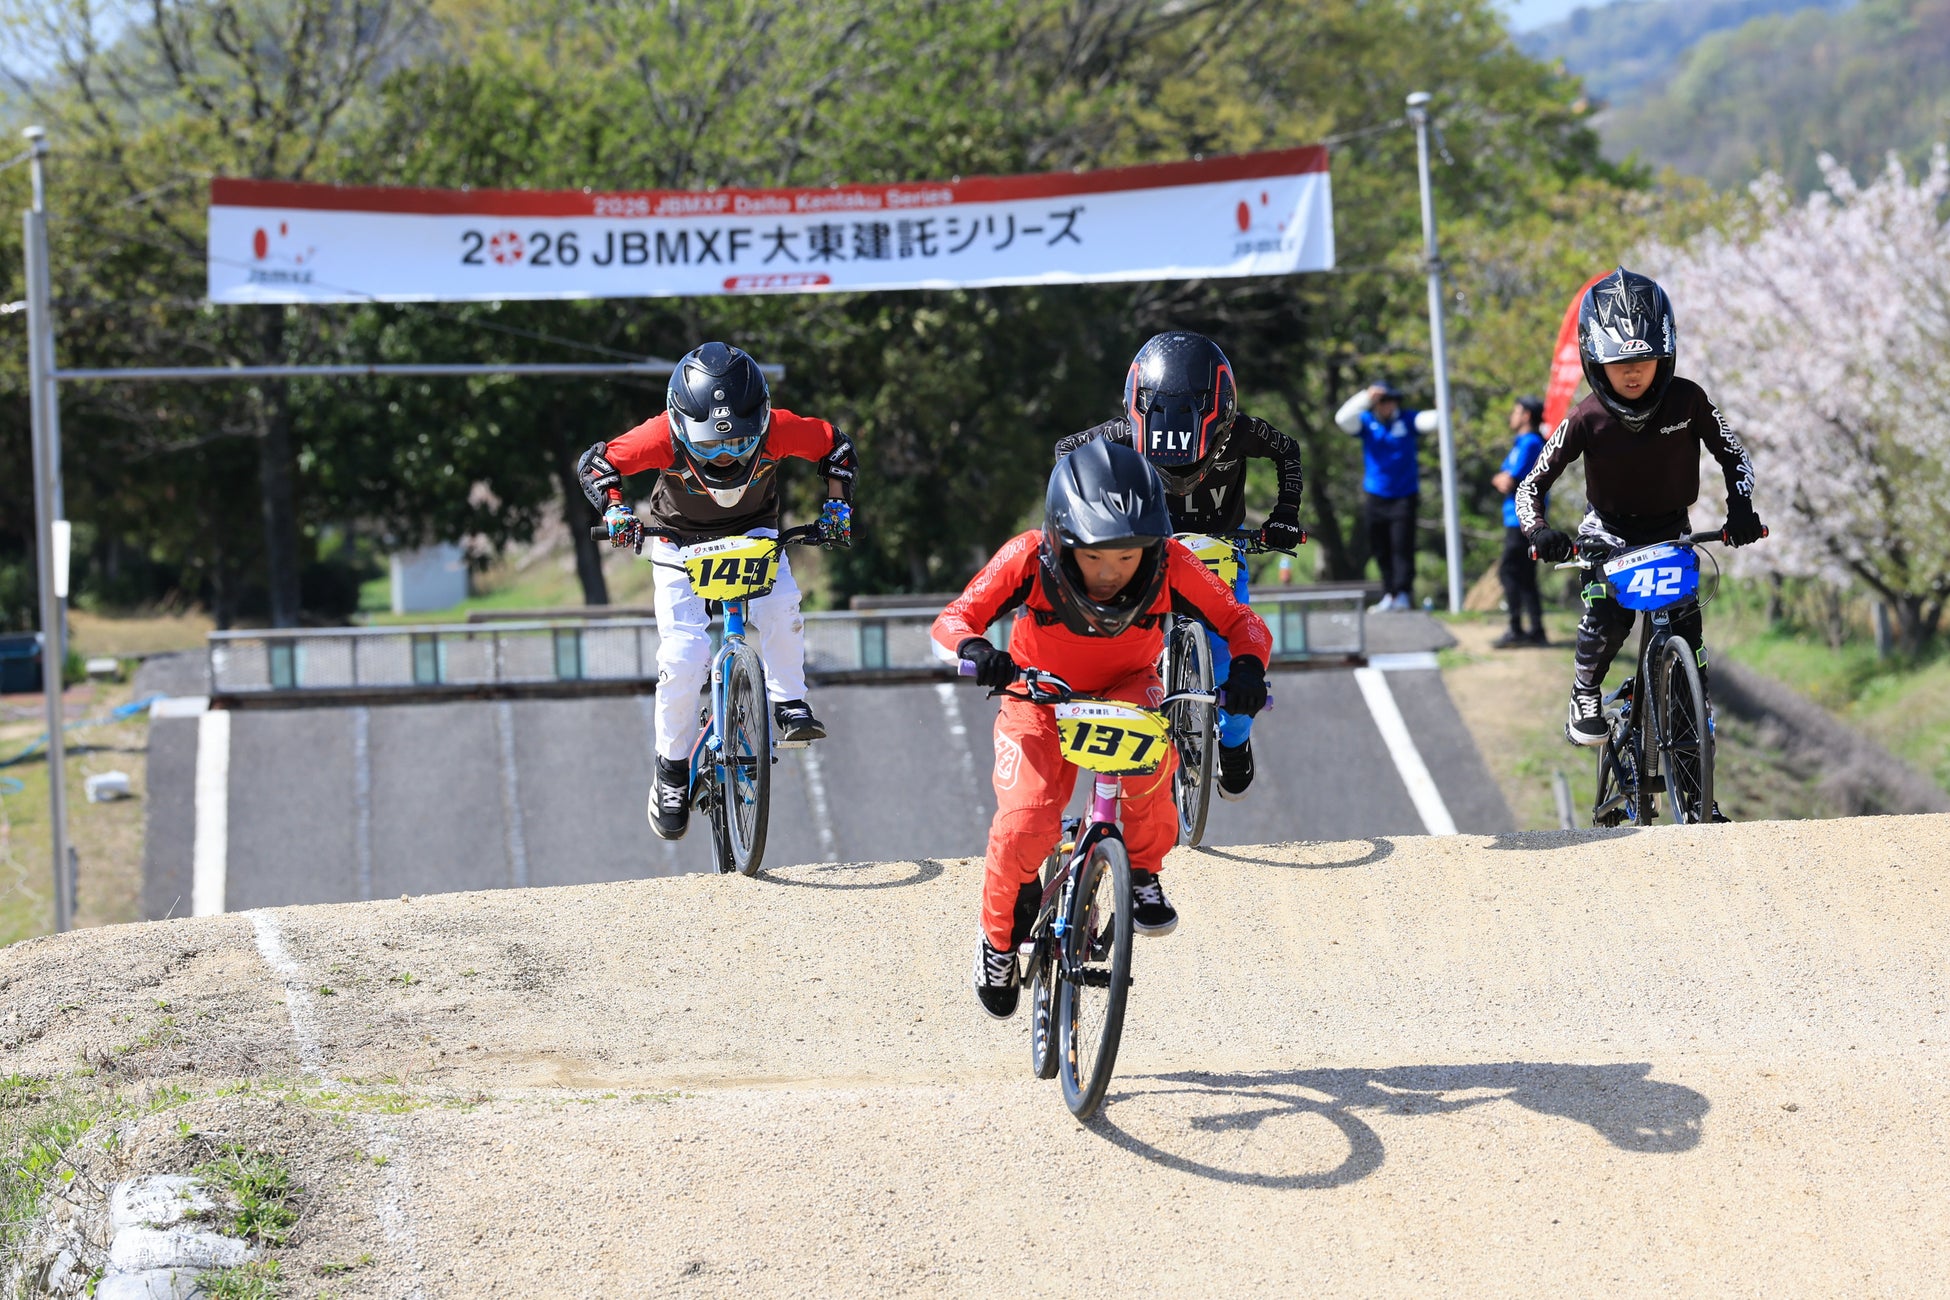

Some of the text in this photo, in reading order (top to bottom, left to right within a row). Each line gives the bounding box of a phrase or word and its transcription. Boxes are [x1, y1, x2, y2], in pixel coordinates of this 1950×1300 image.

[592, 187, 953, 218] 2026 JBMXF Daito Kentaku Series
[1152, 431, 1192, 450] FLY
[698, 557, 769, 587] 149
[1626, 566, 1682, 597] 42
[1070, 721, 1155, 763] 137
